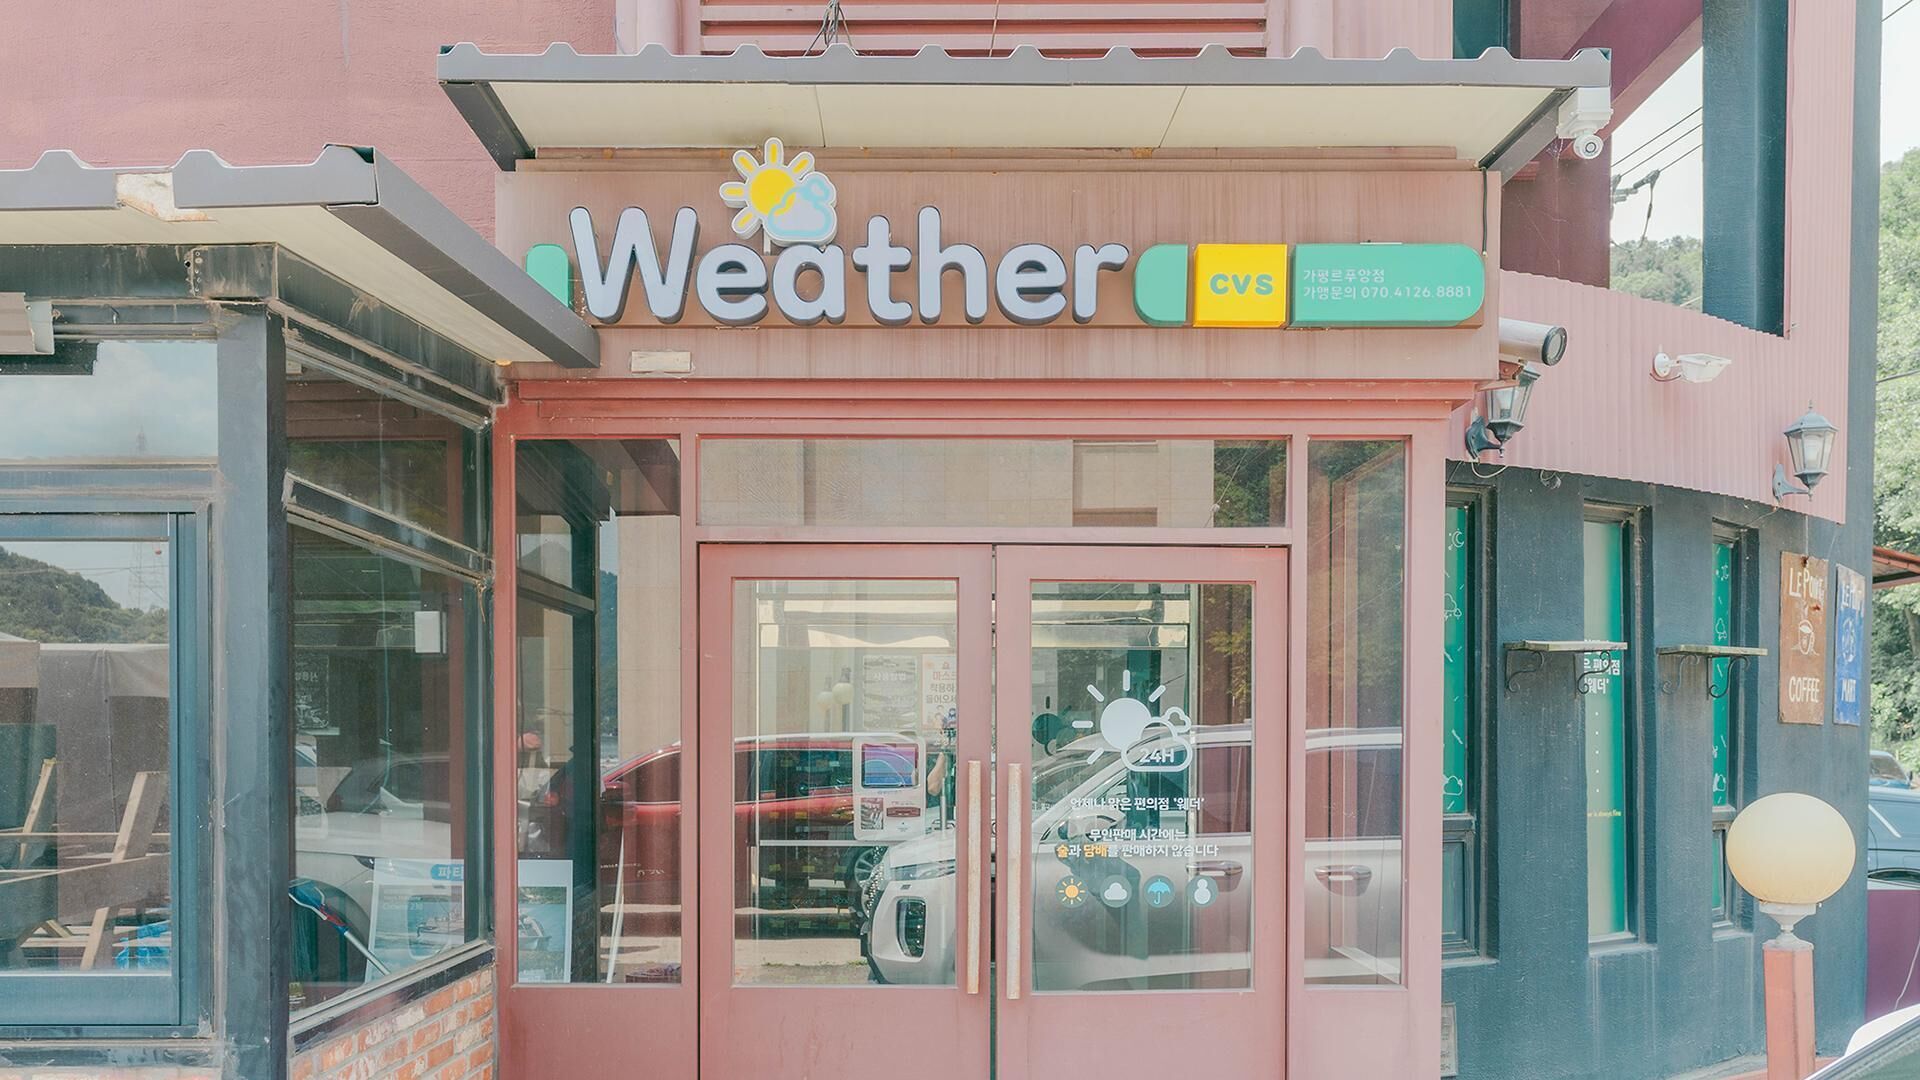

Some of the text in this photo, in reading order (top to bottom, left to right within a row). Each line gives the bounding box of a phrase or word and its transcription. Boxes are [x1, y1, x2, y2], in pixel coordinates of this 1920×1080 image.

[569, 205, 1130, 326] Weather
[1303, 268, 1385, 283] 가평르푸앙점
[1209, 273, 1275, 295] CVS
[1303, 285, 1471, 300] 가맹문의 070.4126.8881
[1789, 676, 1820, 703] COFFEE
[1139, 747, 1175, 764] 24H
[1071, 798, 1106, 811] 언제나
[1109, 798, 1132, 811] 맑은
[1134, 797, 1169, 811] 편의점
[1089, 829, 1187, 842] 무인판매 시간에는
[1056, 844, 1219, 858] 술과 담배를 판매하지 않습니다
